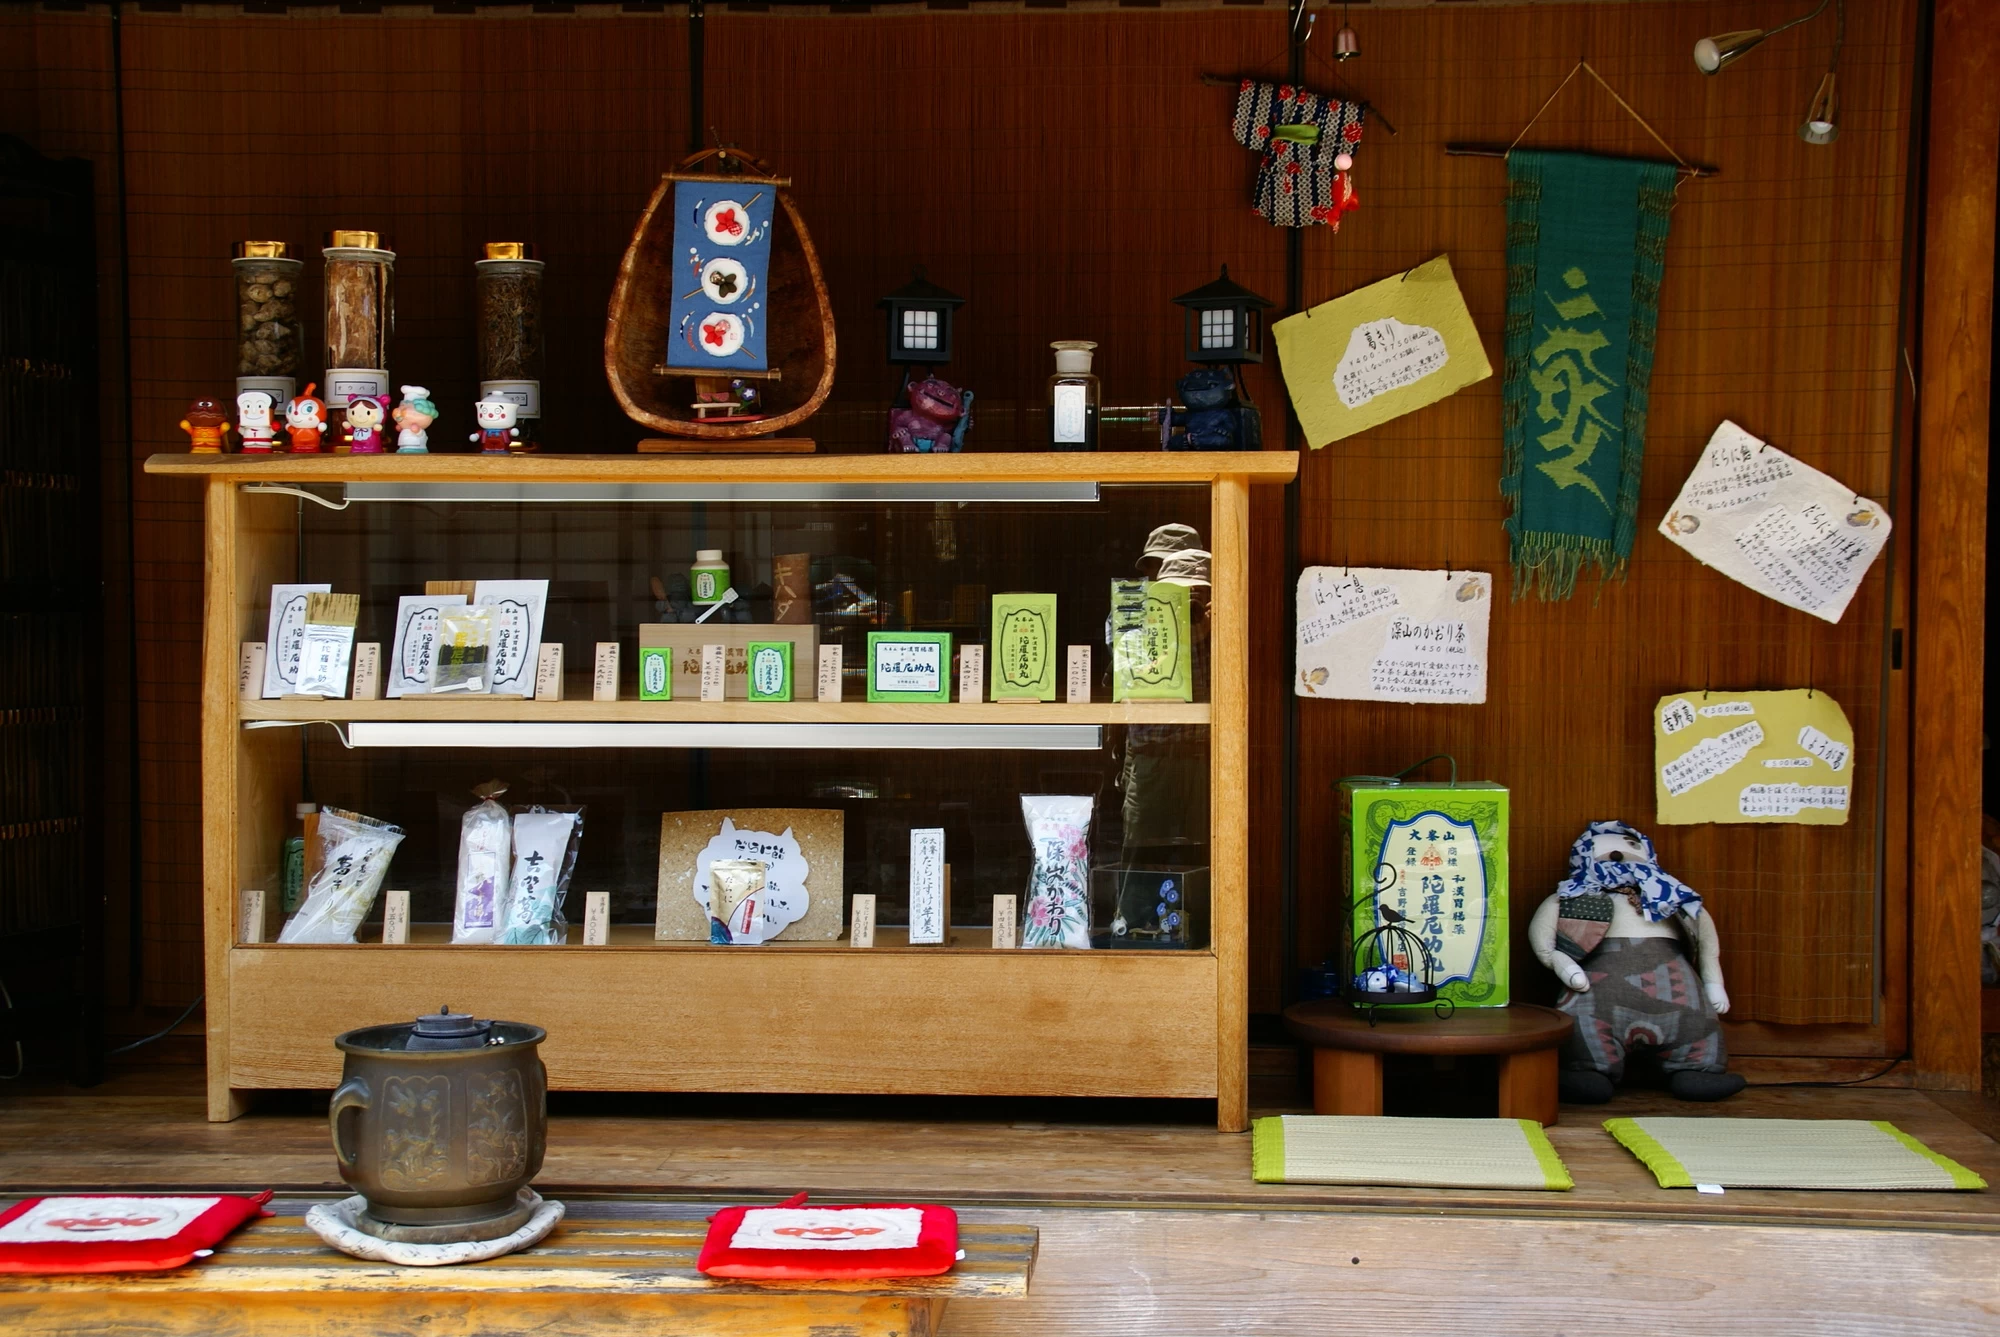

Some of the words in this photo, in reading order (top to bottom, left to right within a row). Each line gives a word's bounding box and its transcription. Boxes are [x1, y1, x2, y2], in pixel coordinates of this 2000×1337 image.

[1363, 323, 1395, 350] 葛きり
[1019, 636, 1030, 679] 陀羅尼助丸
[1391, 622, 1465, 643] 深山のかおり茶
[881, 662, 935, 673] 陀羅尼助丸
[1409, 829, 1455, 841] 大峯山
[516, 850, 544, 924] 吉野葛
[921, 856, 936, 935] だらにすけ羊羹
[1046, 840, 1065, 936] 深山のかおり
[1452, 874, 1466, 935] 和漢胃腸薬
[1420, 874, 1445, 972] 陀羅尼助丸
